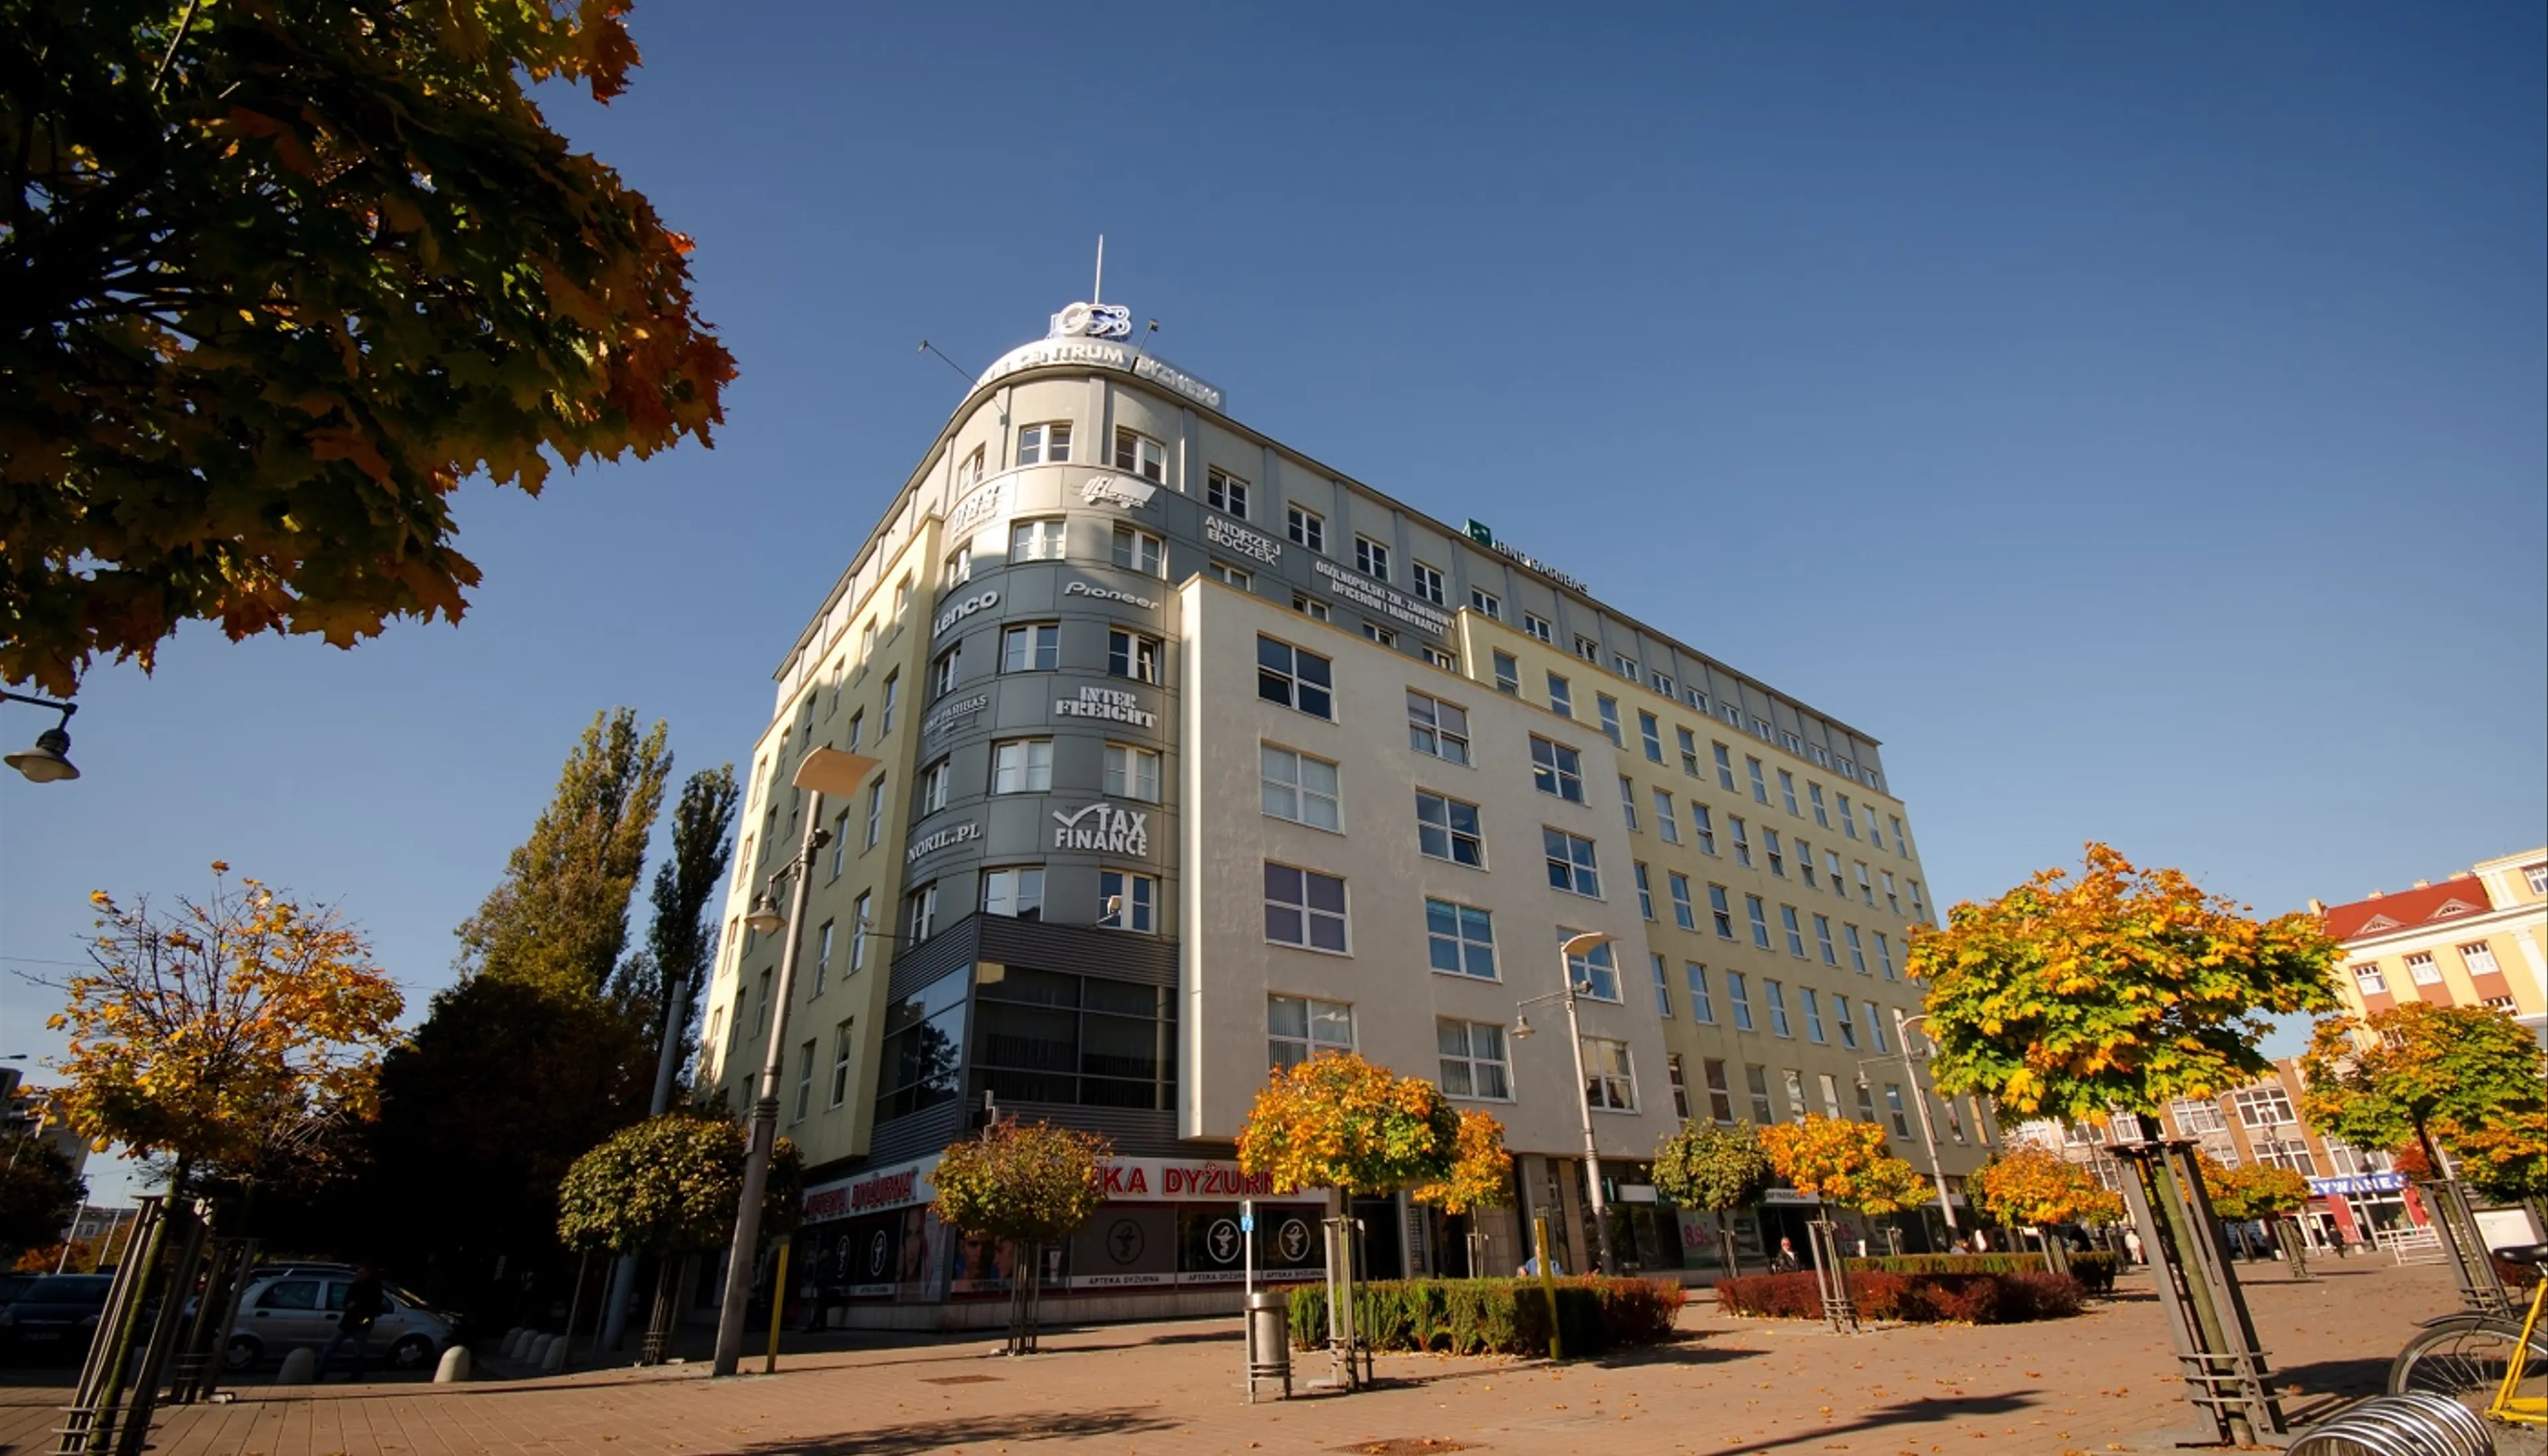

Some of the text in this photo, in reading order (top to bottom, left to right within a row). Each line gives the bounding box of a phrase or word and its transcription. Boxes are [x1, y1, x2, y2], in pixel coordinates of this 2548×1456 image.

[1019, 343, 1125, 367] CENTRUM
[1205, 515, 1281, 556] ANDRZEJ
[1207, 527, 1277, 566] BOCZEK
[1064, 581, 1160, 610] Pioneer
[1080, 685, 1137, 710] INTER
[1056, 699, 1158, 728] FREIGHT
[1096, 807, 1147, 838] TAX
[1054, 827, 1147, 857] FINANCE
[1089, 1275, 1160, 1285] APTEKA DYŻURNA
[1187, 1273, 1216, 1282] APTEKA
